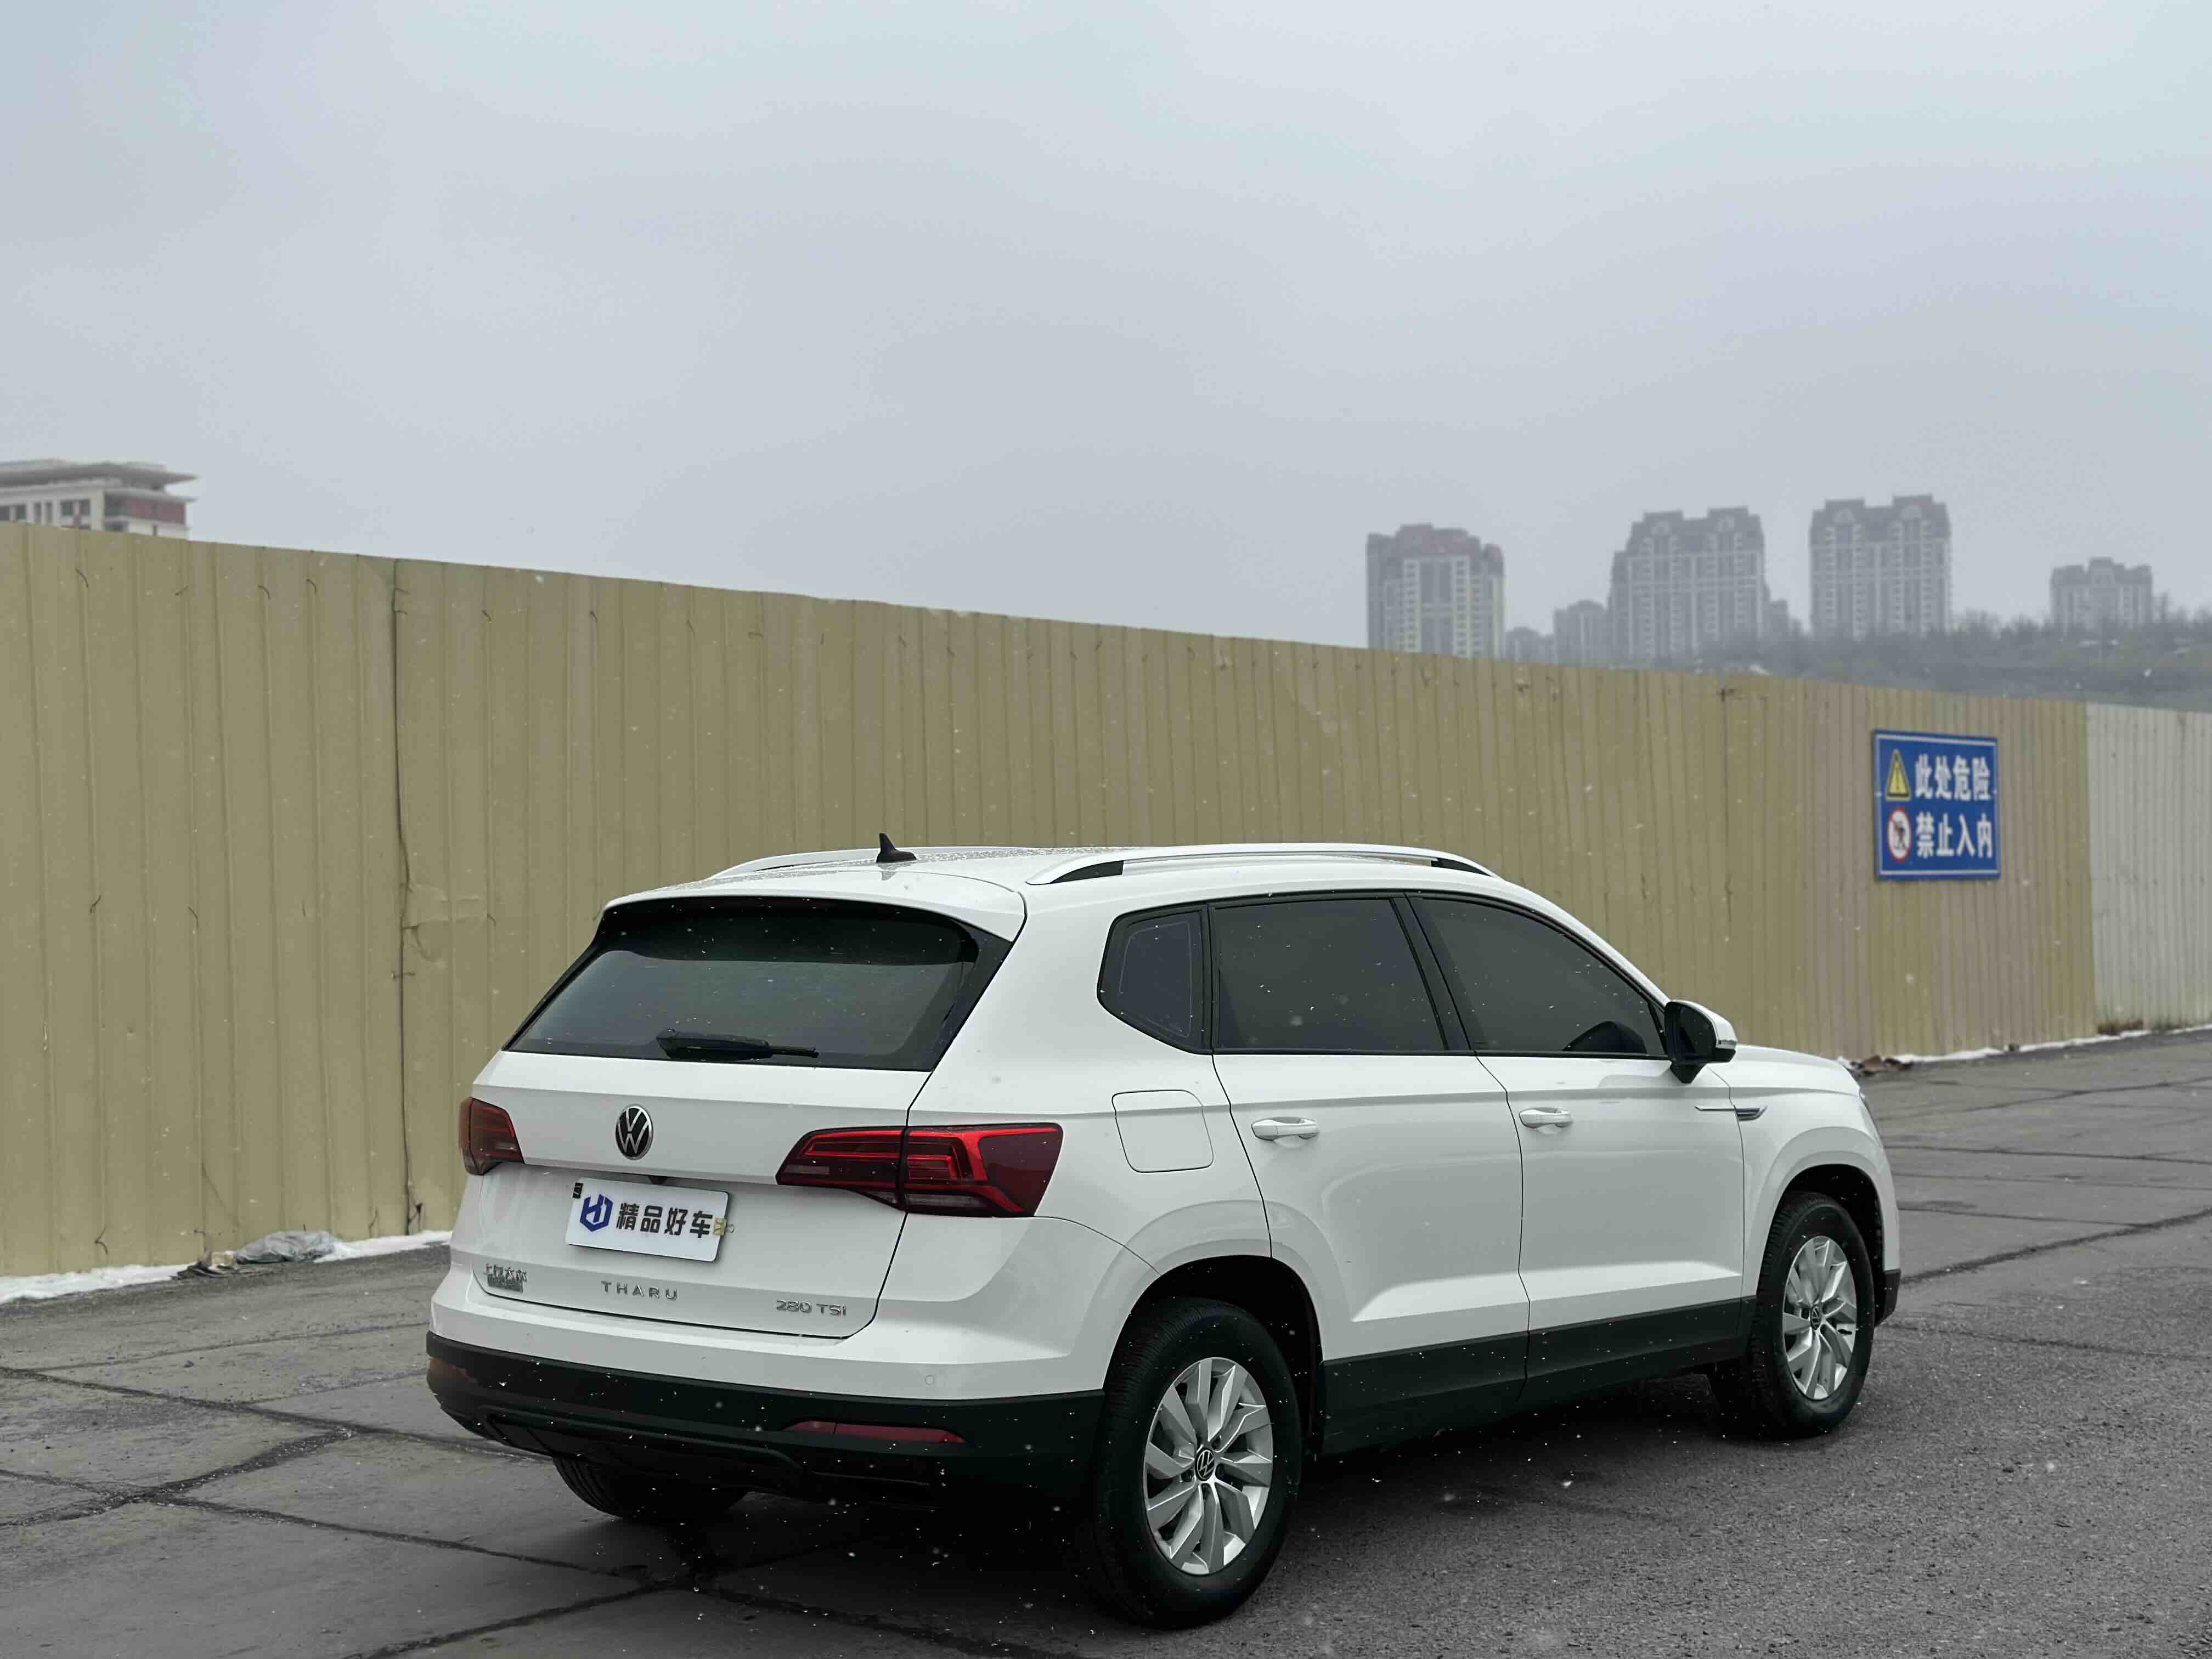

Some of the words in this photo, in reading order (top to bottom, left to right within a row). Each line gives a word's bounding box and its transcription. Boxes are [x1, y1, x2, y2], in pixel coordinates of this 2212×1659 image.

[1915, 753, 1991, 801] 此处危险
[1916, 811, 1993, 859] 禁止入内
[616, 1202, 713, 1238] 精品好车
[601, 1281, 678, 1300] THARU
[776, 1299, 811, 1313] 280
[816, 1303, 847, 1316] TSI
